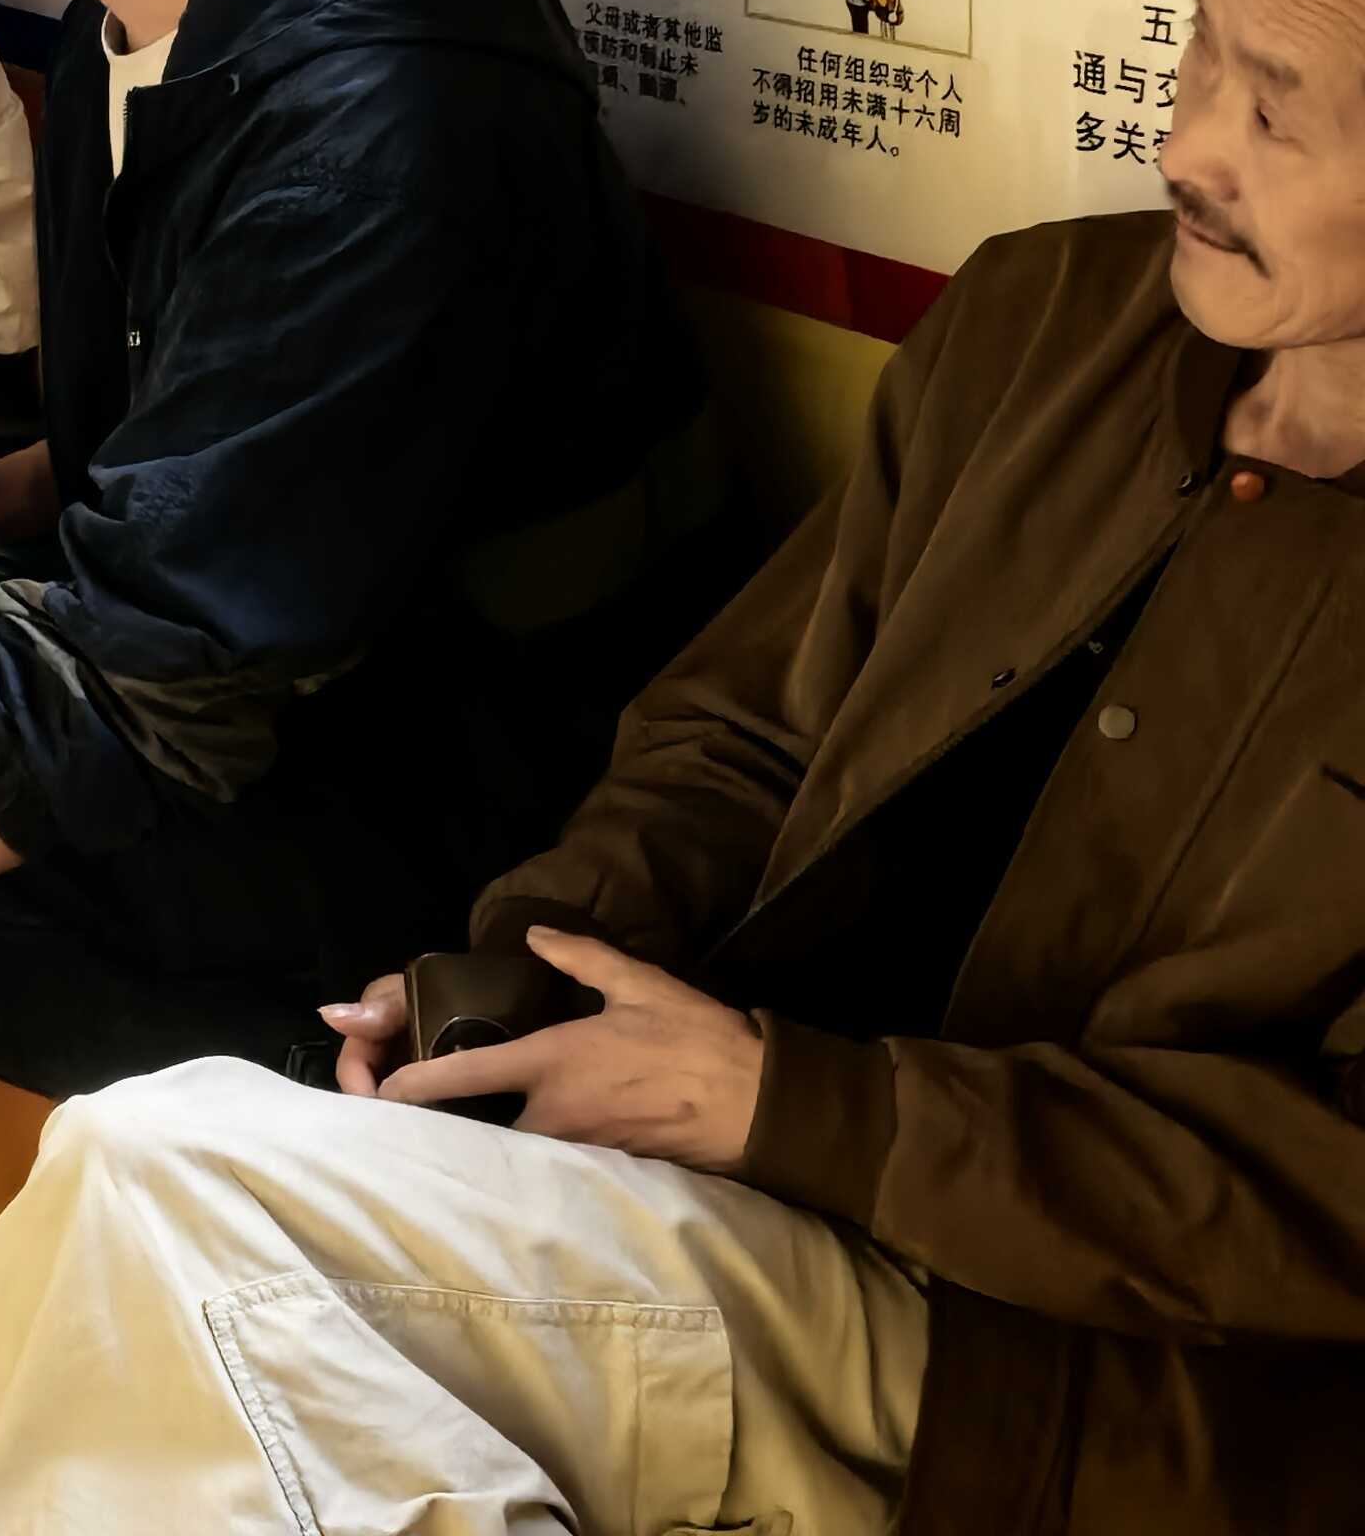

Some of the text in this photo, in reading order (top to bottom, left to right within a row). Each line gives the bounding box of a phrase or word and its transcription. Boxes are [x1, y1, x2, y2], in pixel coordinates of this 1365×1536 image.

[585, 1, 724, 54] 父母或者其他监
[1141, 5, 1178, 46] 五
[751, 67, 962, 139] 不得招用未满十六周
[795, 46, 965, 105] 任何组织或个人
[751, 99, 903, 158] 岁的未成年人。
